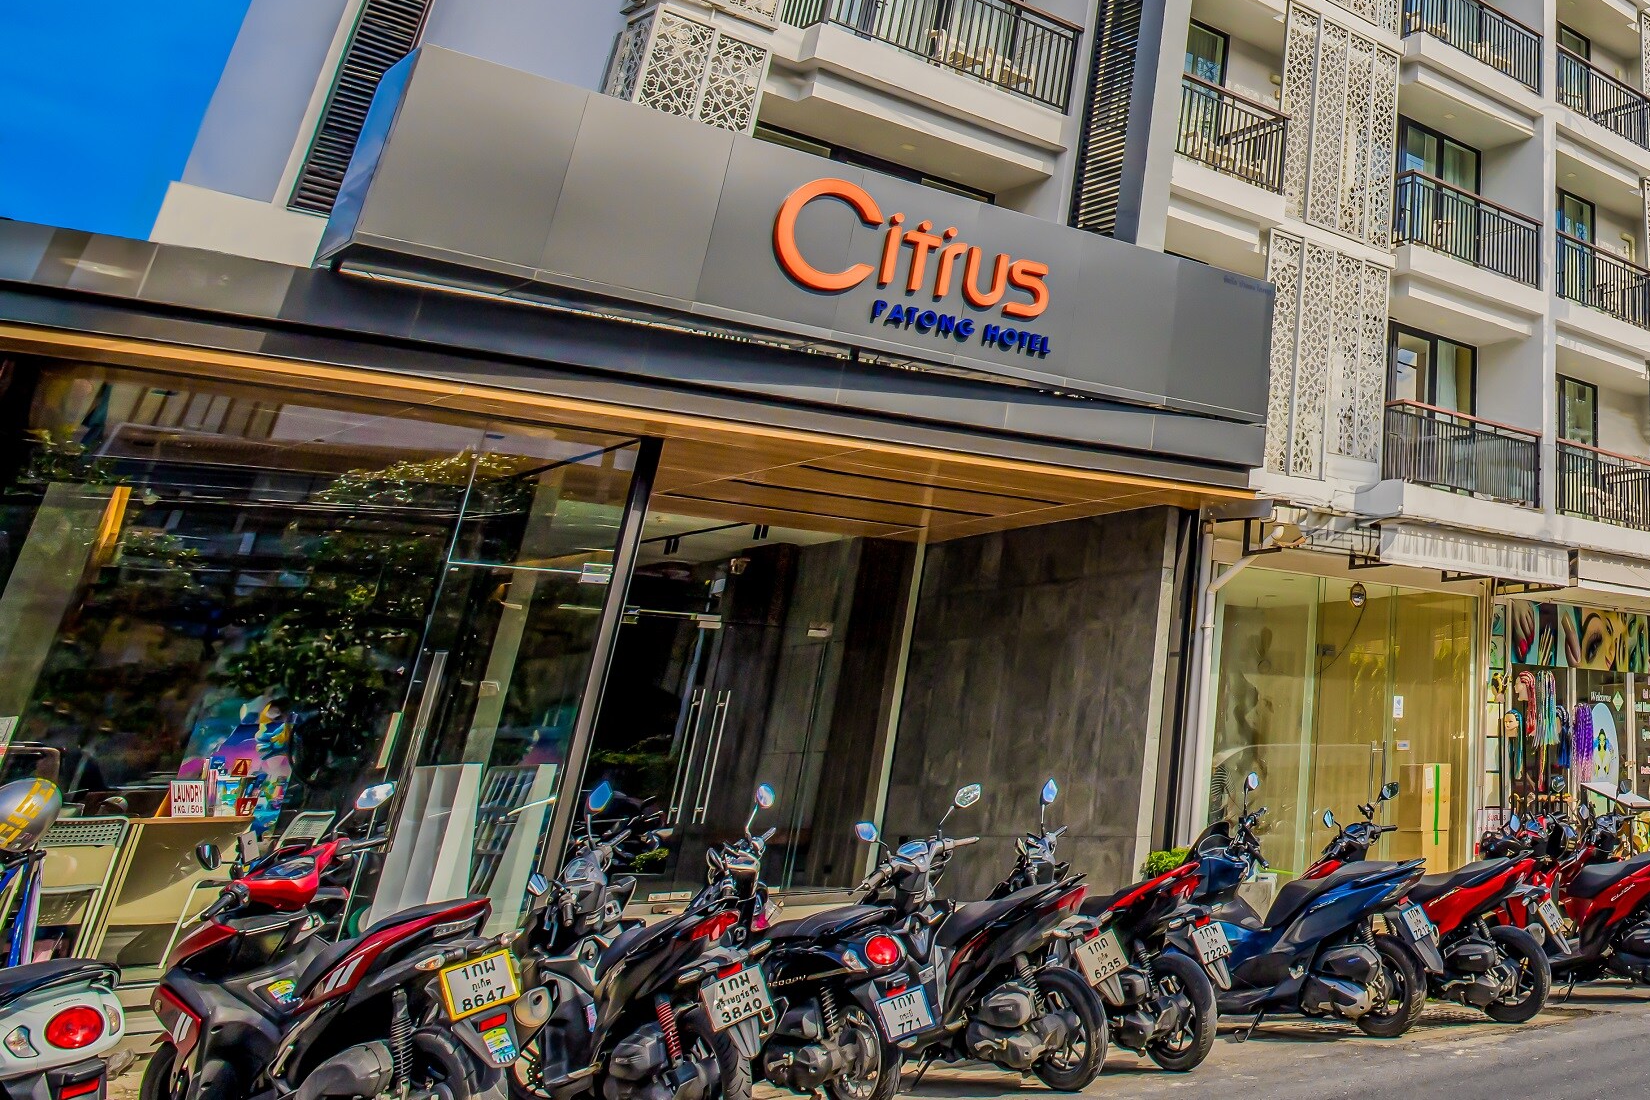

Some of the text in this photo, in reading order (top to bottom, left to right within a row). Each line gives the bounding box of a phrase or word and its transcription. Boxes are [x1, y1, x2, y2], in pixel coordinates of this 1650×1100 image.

[773, 178, 1049, 318] Citrus
[873, 299, 1051, 355] PATONG HOTEL
[1590, 691, 1611, 703] Welcome
[173, 784, 202, 803] LAUNDRY
[1203, 944, 1229, 962] 7220
[1094, 957, 1121, 979] 6235
[461, 985, 507, 1012] 8647
[721, 997, 763, 1024] 3840
[897, 1017, 922, 1034] 771
